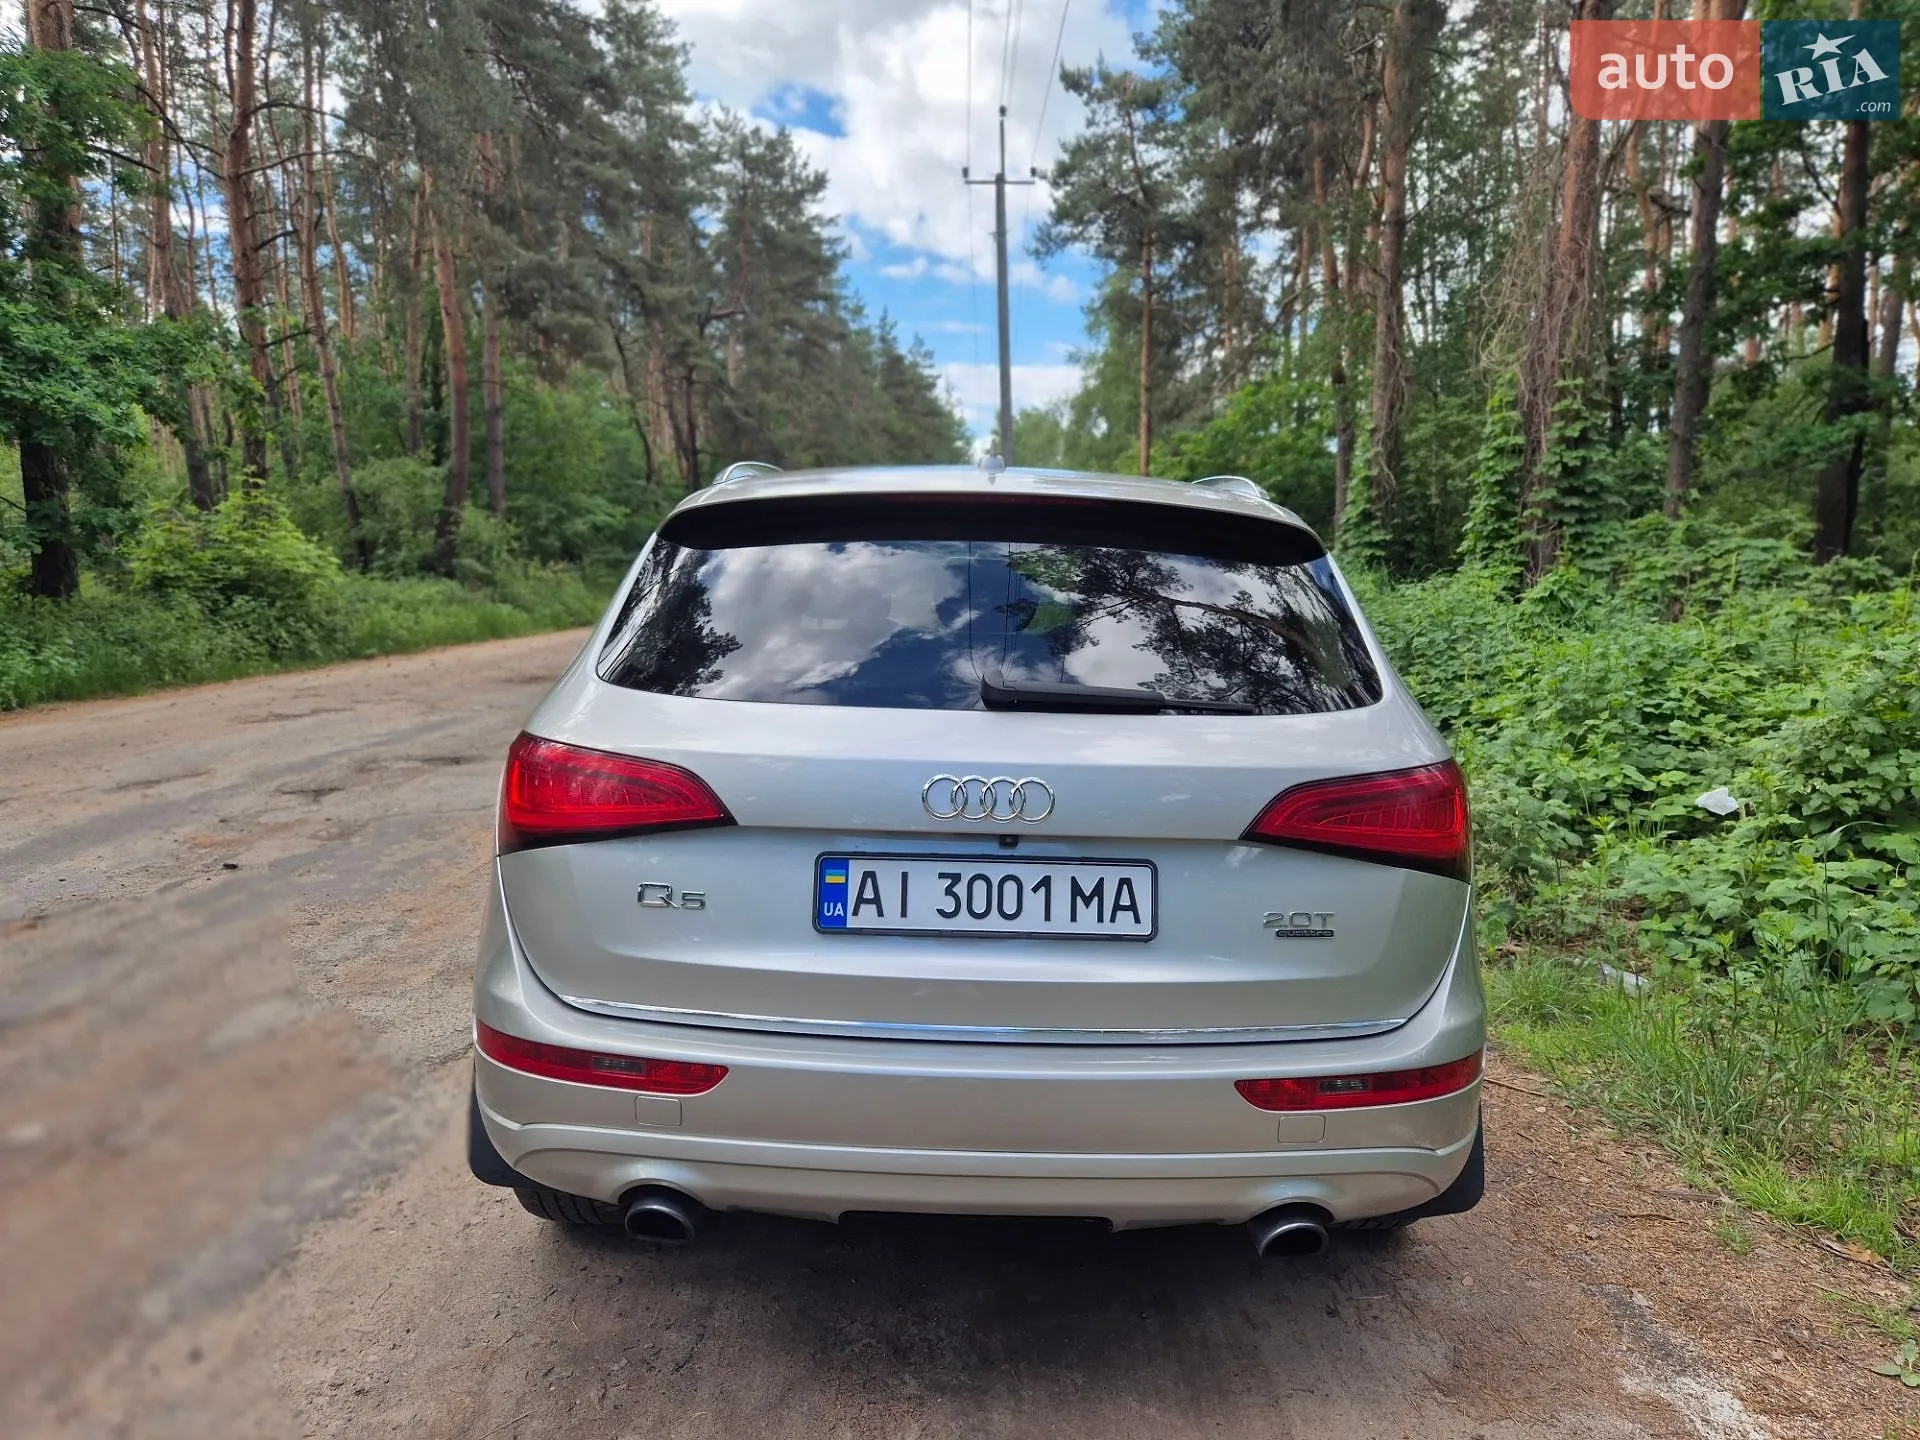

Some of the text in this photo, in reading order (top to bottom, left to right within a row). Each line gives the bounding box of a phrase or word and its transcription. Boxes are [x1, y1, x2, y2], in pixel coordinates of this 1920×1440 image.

[637, 881, 706, 910] Q5
[824, 902, 845, 917] UA
[852, 870, 1141, 924] AI 3001 MA
